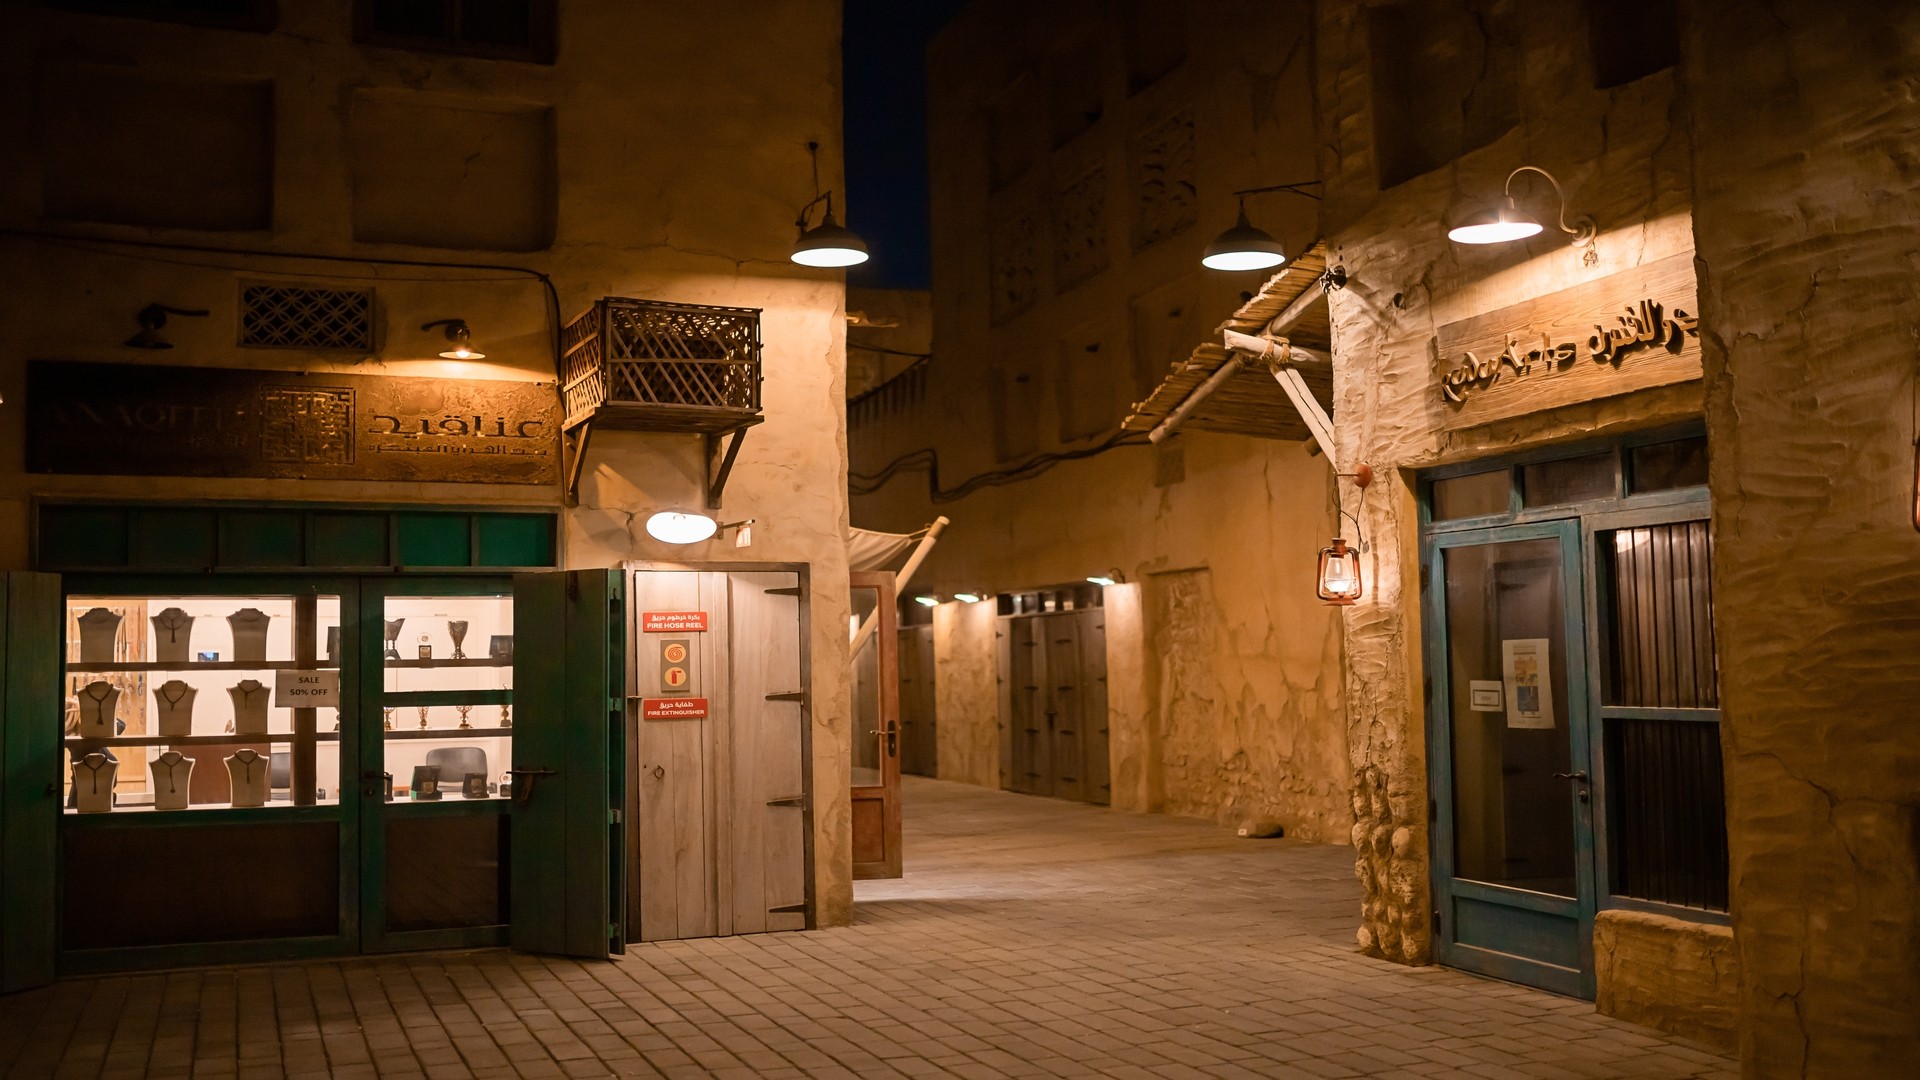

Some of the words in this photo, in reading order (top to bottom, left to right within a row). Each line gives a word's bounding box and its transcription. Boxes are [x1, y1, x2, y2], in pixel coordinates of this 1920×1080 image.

[369, 415, 543, 439] عناقيد
[511, 447, 547, 458] بيت
[651, 614, 666, 622] حريق
[298, 676, 320, 684] SALE
[290, 688, 309, 696] 50%
[311, 688, 328, 696] OFF
